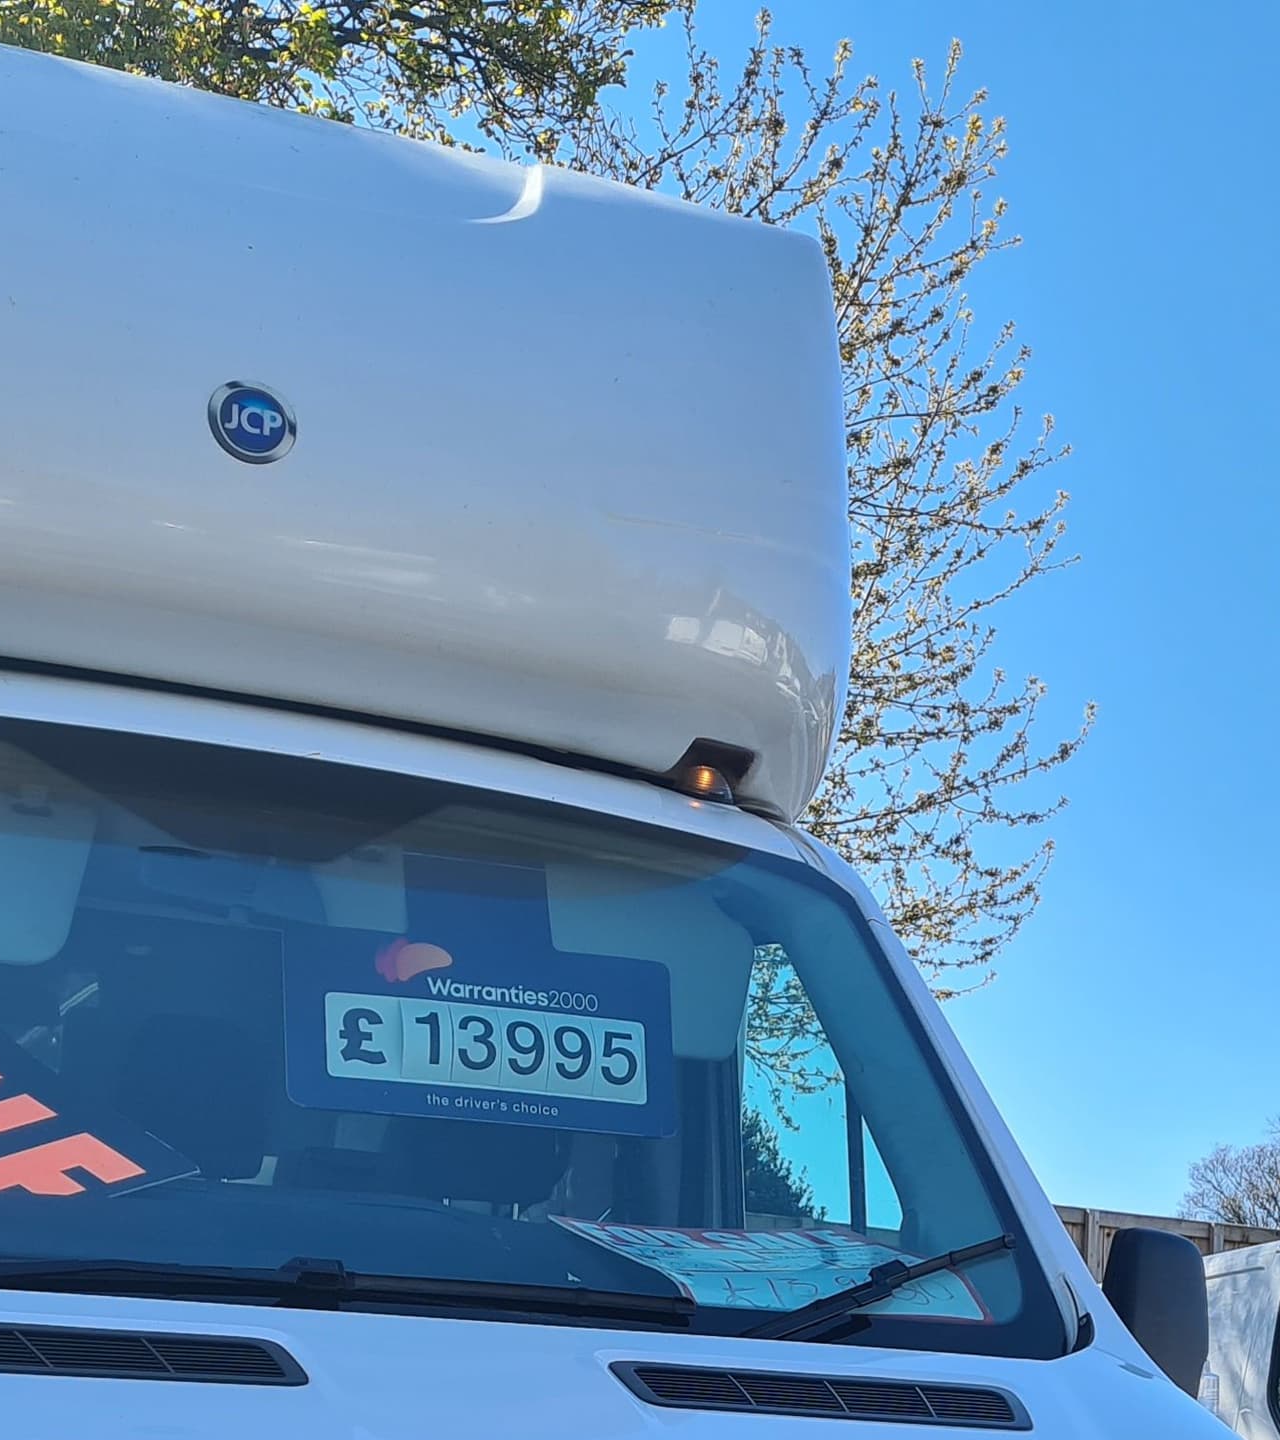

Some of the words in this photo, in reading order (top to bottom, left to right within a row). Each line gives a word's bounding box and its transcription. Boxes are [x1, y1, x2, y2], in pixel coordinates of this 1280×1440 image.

[224, 403, 282, 435] JCP
[427, 976, 598, 1011] Warranties2000
[415, 1012, 638, 1085] 13995
[427, 1094, 449, 1106] the
[454, 1096, 507, 1111] driver's
[513, 1101, 559, 1116] choice
[570, 1223, 711, 1249] FOR
[702, 1229, 867, 1250] SALE
